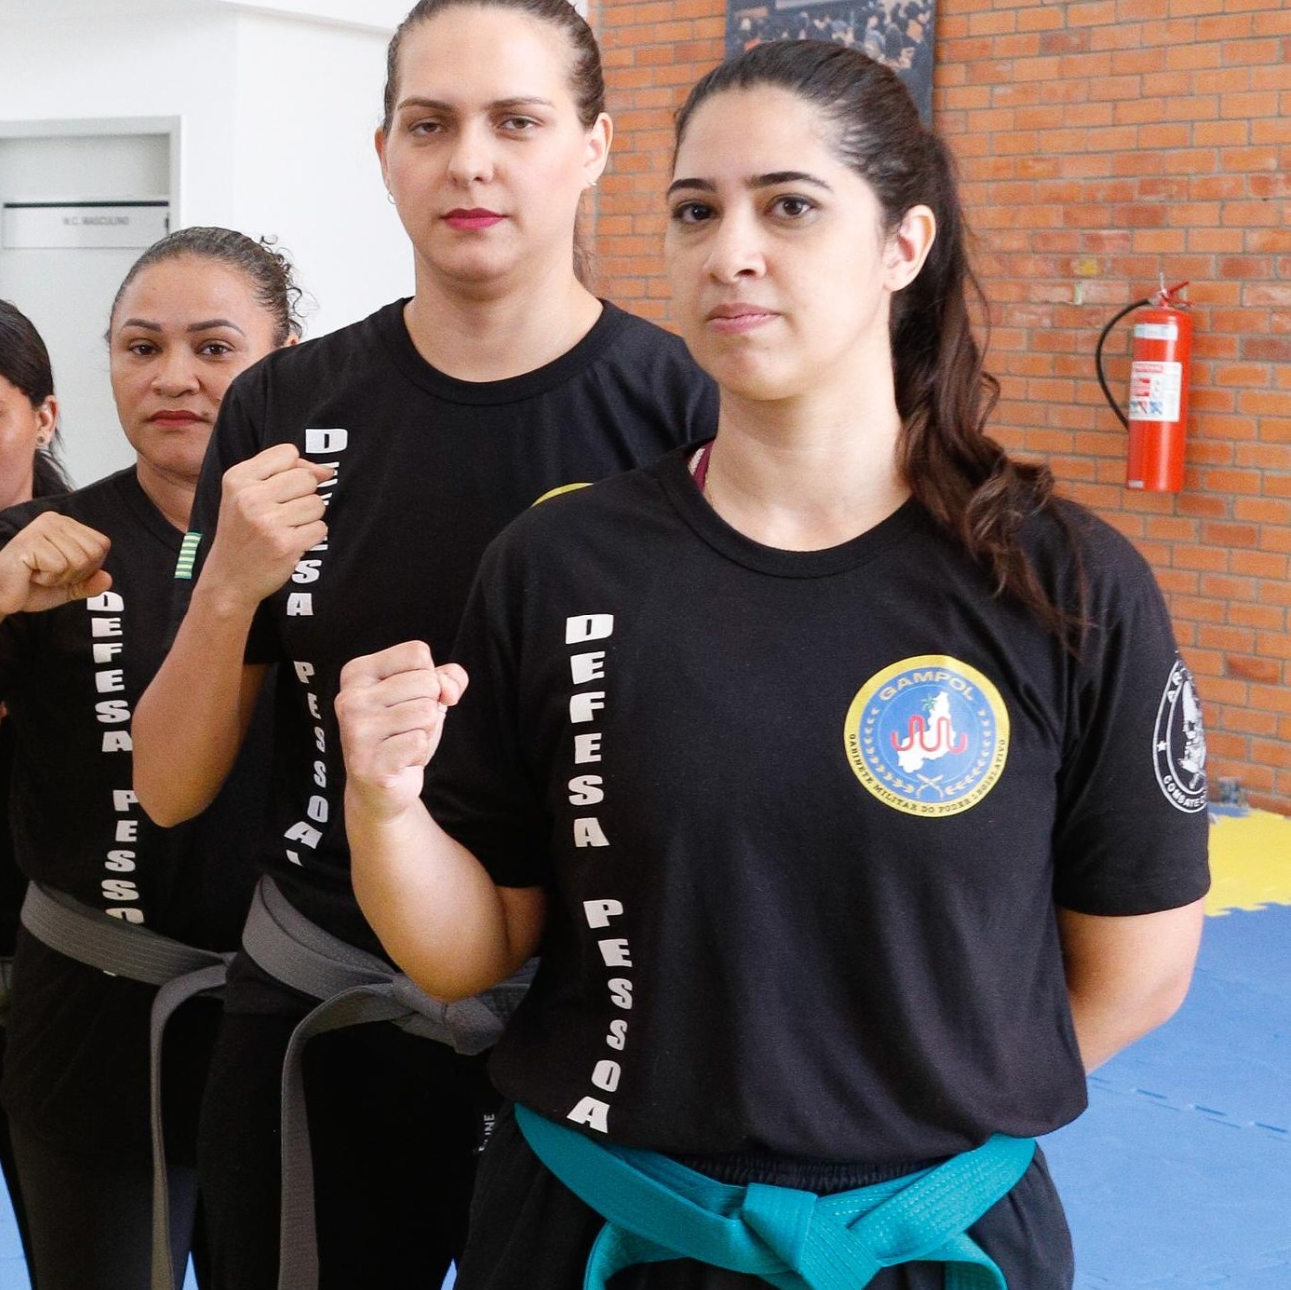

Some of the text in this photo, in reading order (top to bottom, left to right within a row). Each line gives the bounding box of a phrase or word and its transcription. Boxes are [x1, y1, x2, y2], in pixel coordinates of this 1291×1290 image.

[86, 590, 133, 753] DEFESA
[878, 670, 975, 702] GAMPOL
[849, 733, 1007, 814] GABINETE MILITAR DO PODER LEGISLATIVO
[565, 613, 633, 1134] DEFESA PESSOA
